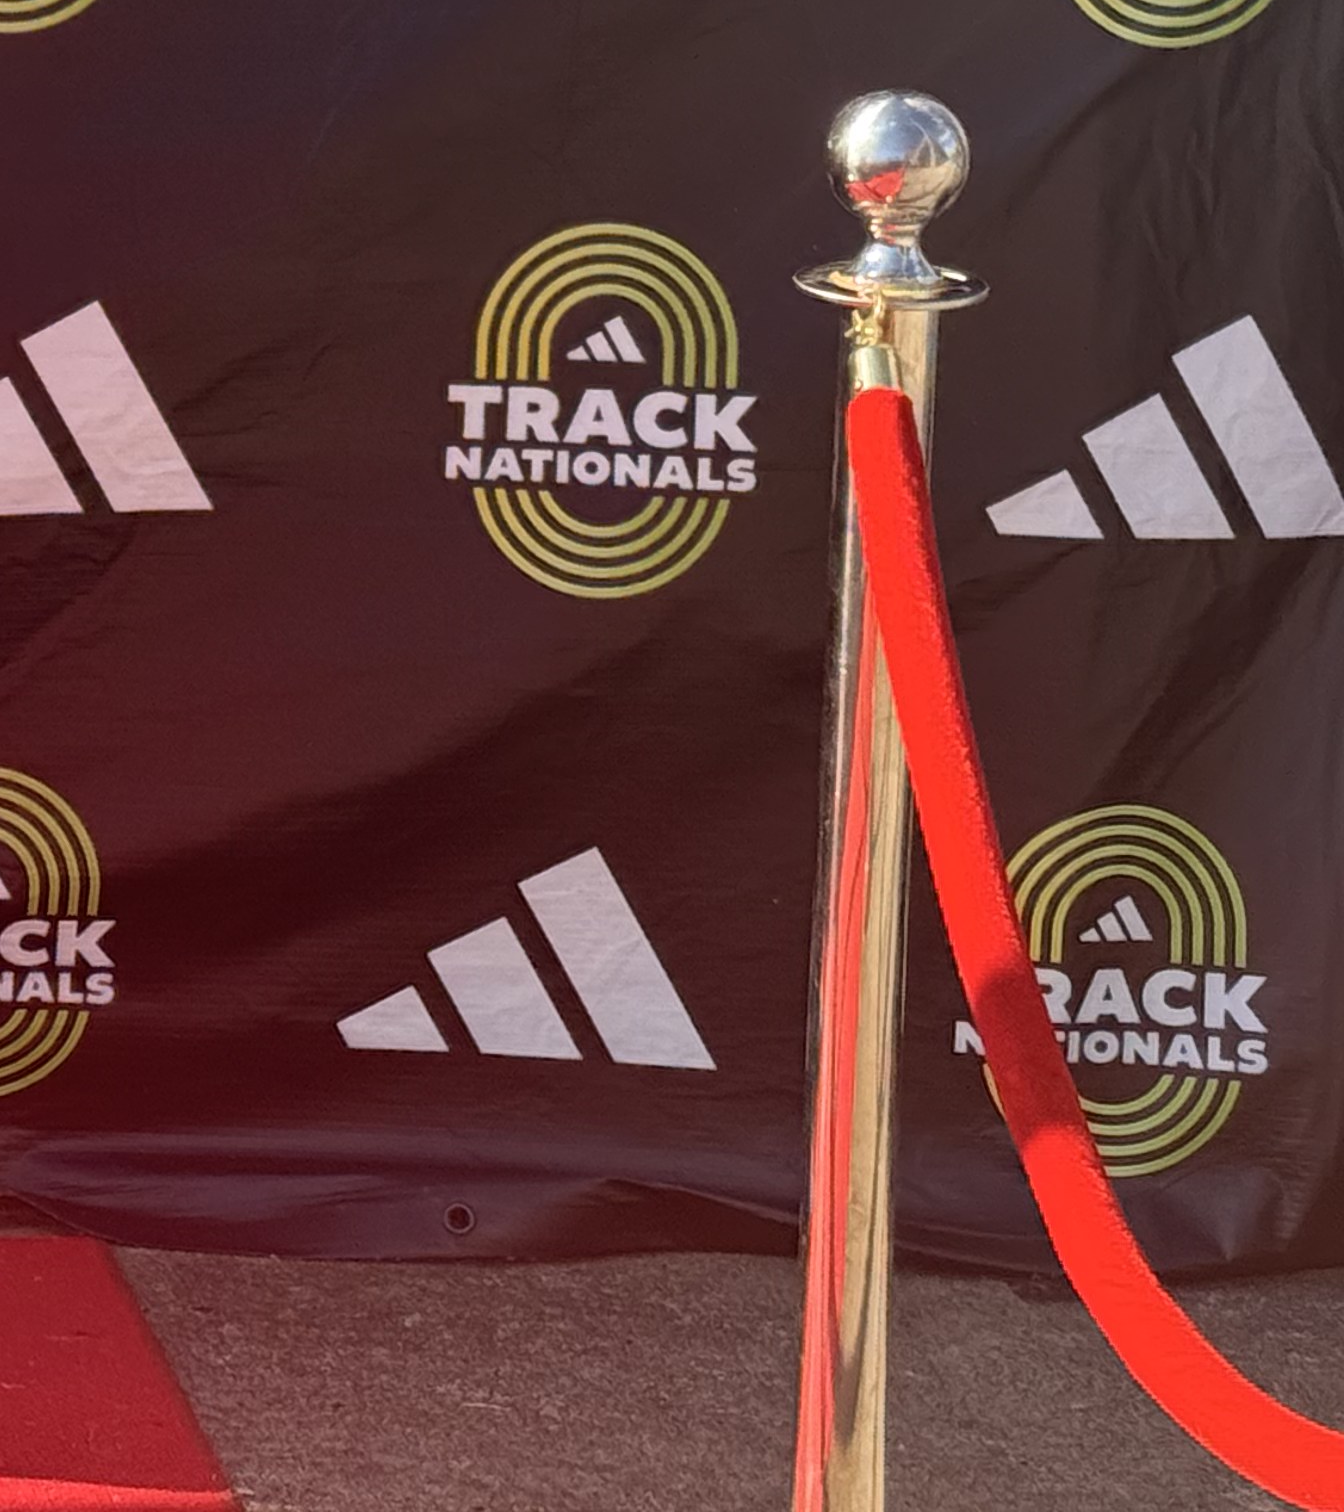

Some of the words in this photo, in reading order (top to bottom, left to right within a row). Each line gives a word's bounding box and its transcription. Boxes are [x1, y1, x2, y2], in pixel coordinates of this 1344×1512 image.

[448, 386, 756, 453] TRACK
[446, 448, 756, 491] NATIONALS
[1033, 967, 1268, 1033] RACK
[953, 1020, 1269, 1075] NIONALS
